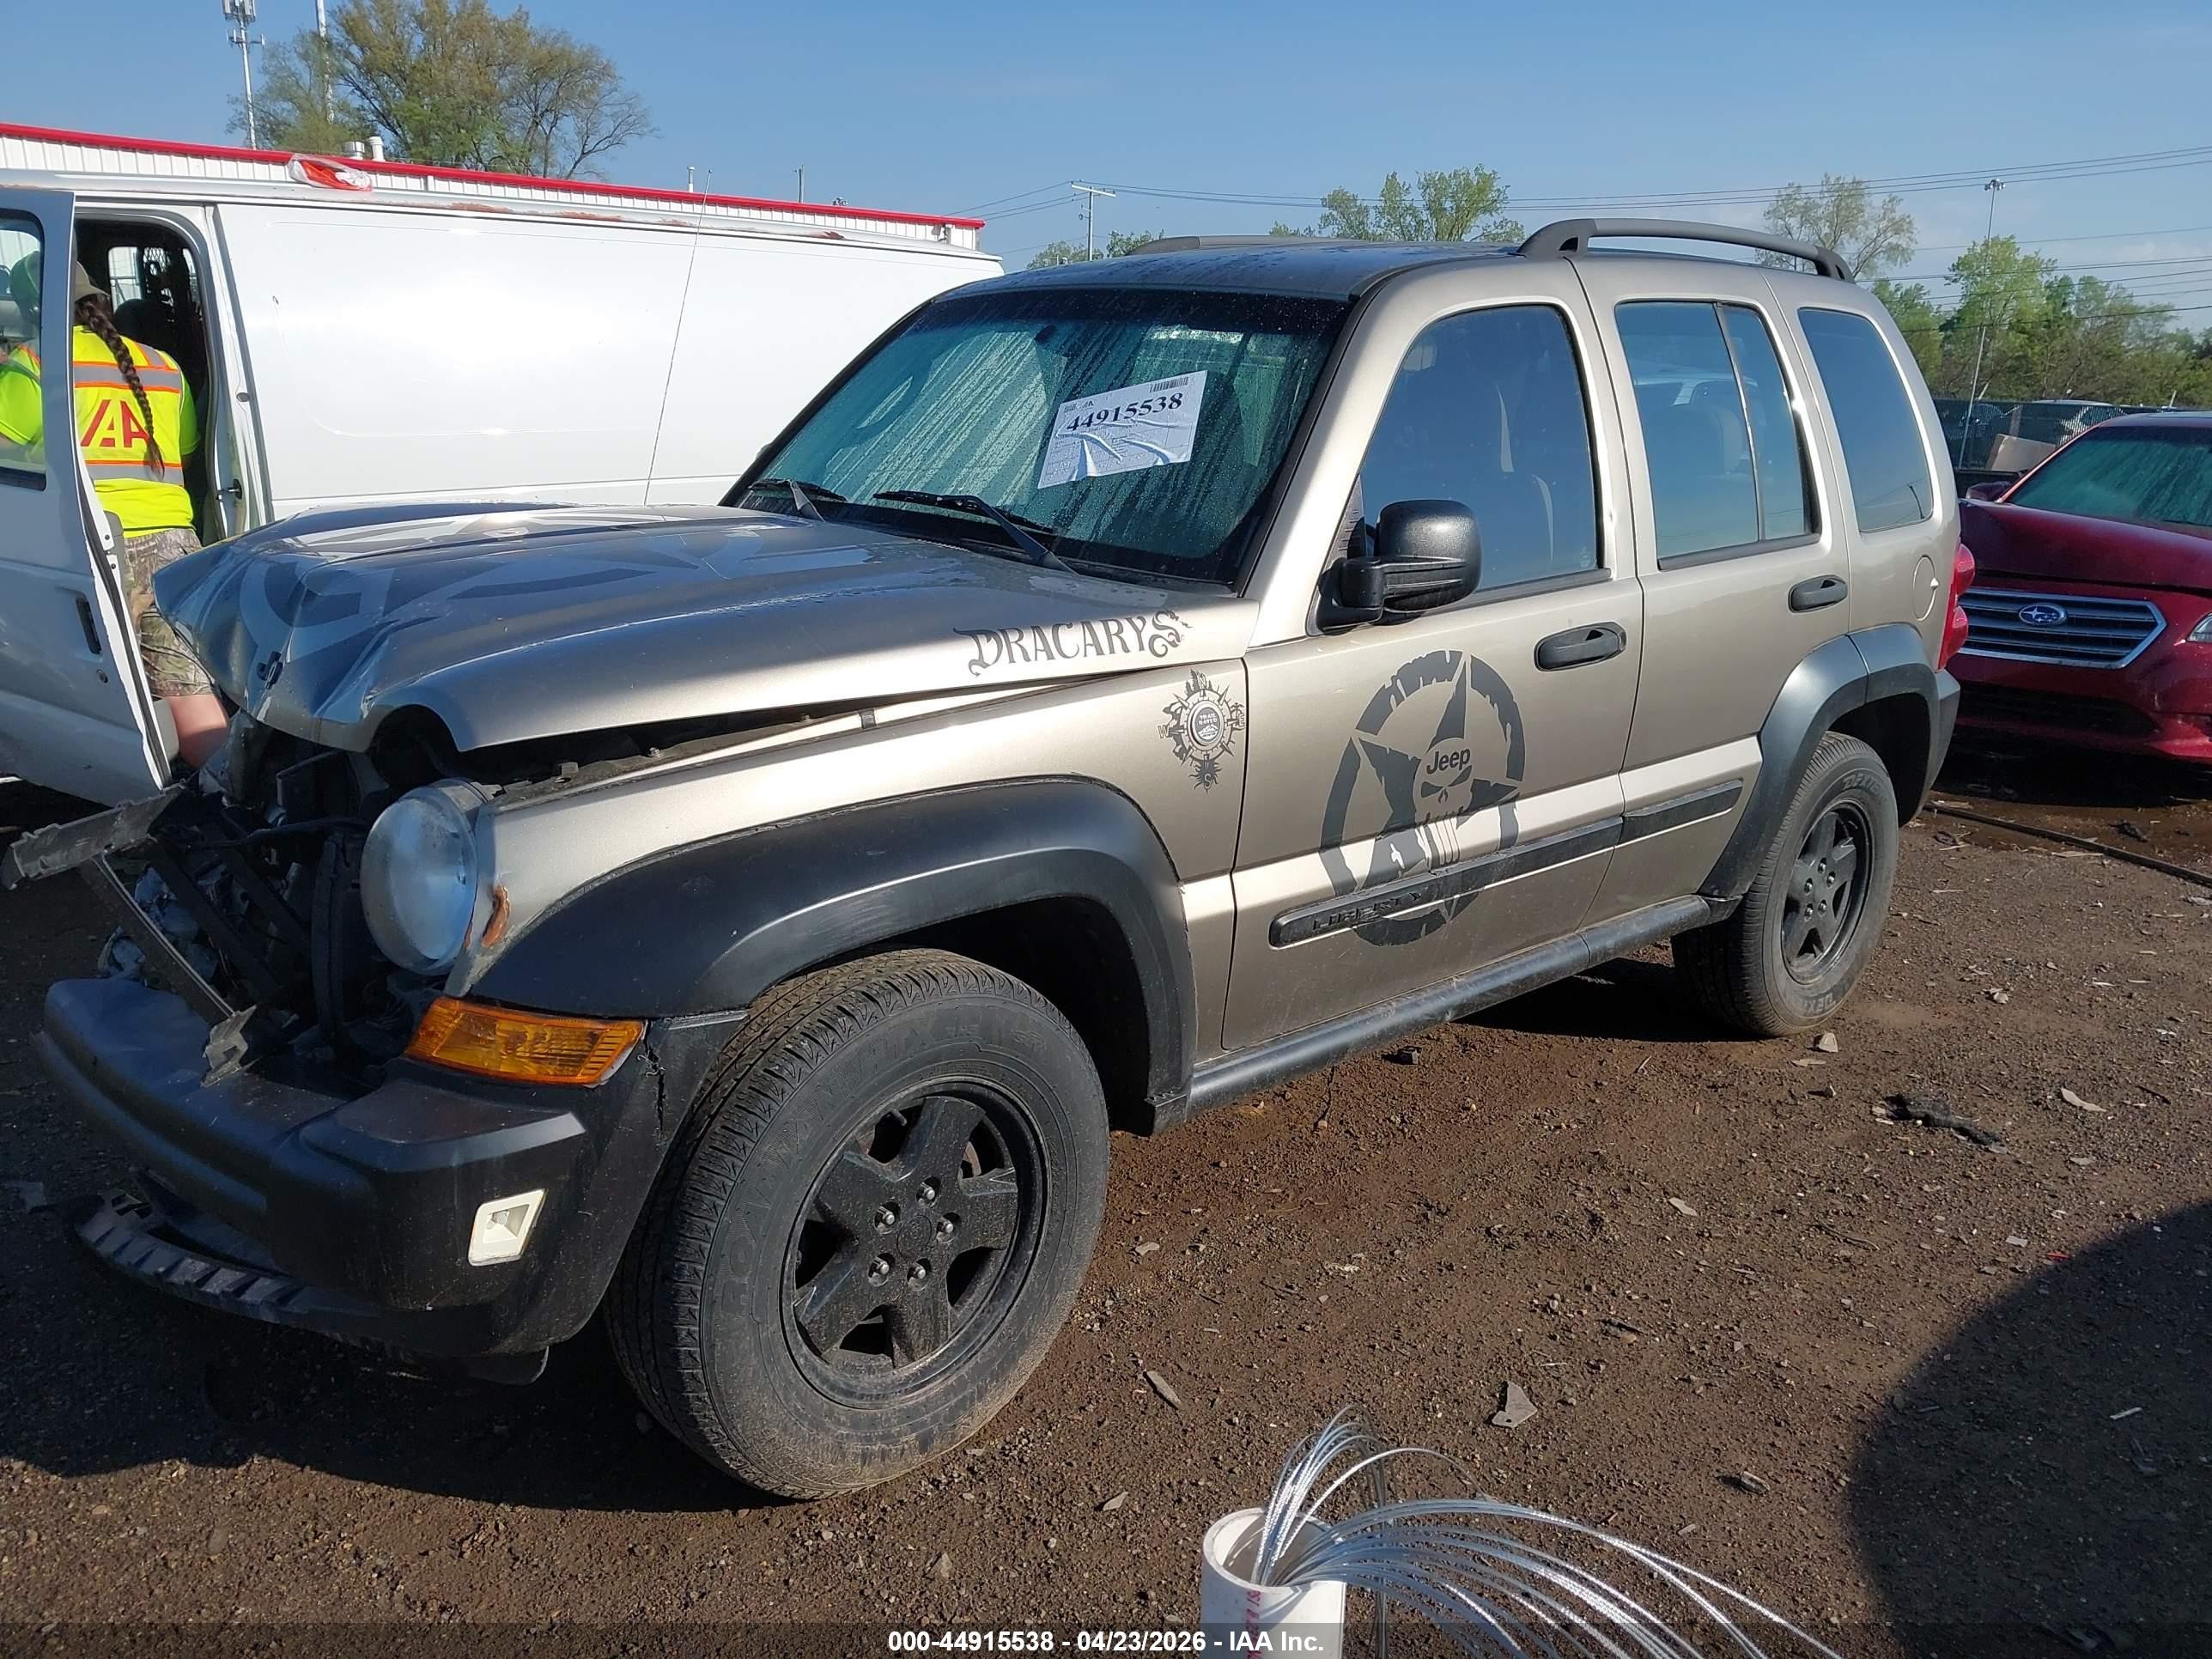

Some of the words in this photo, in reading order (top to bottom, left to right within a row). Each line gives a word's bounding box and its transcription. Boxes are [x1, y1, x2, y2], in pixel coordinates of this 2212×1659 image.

[1066, 392, 1183, 431] 44915538
[953, 609, 1185, 678] DRACARYS
[1426, 747, 1471, 775] Jeep
